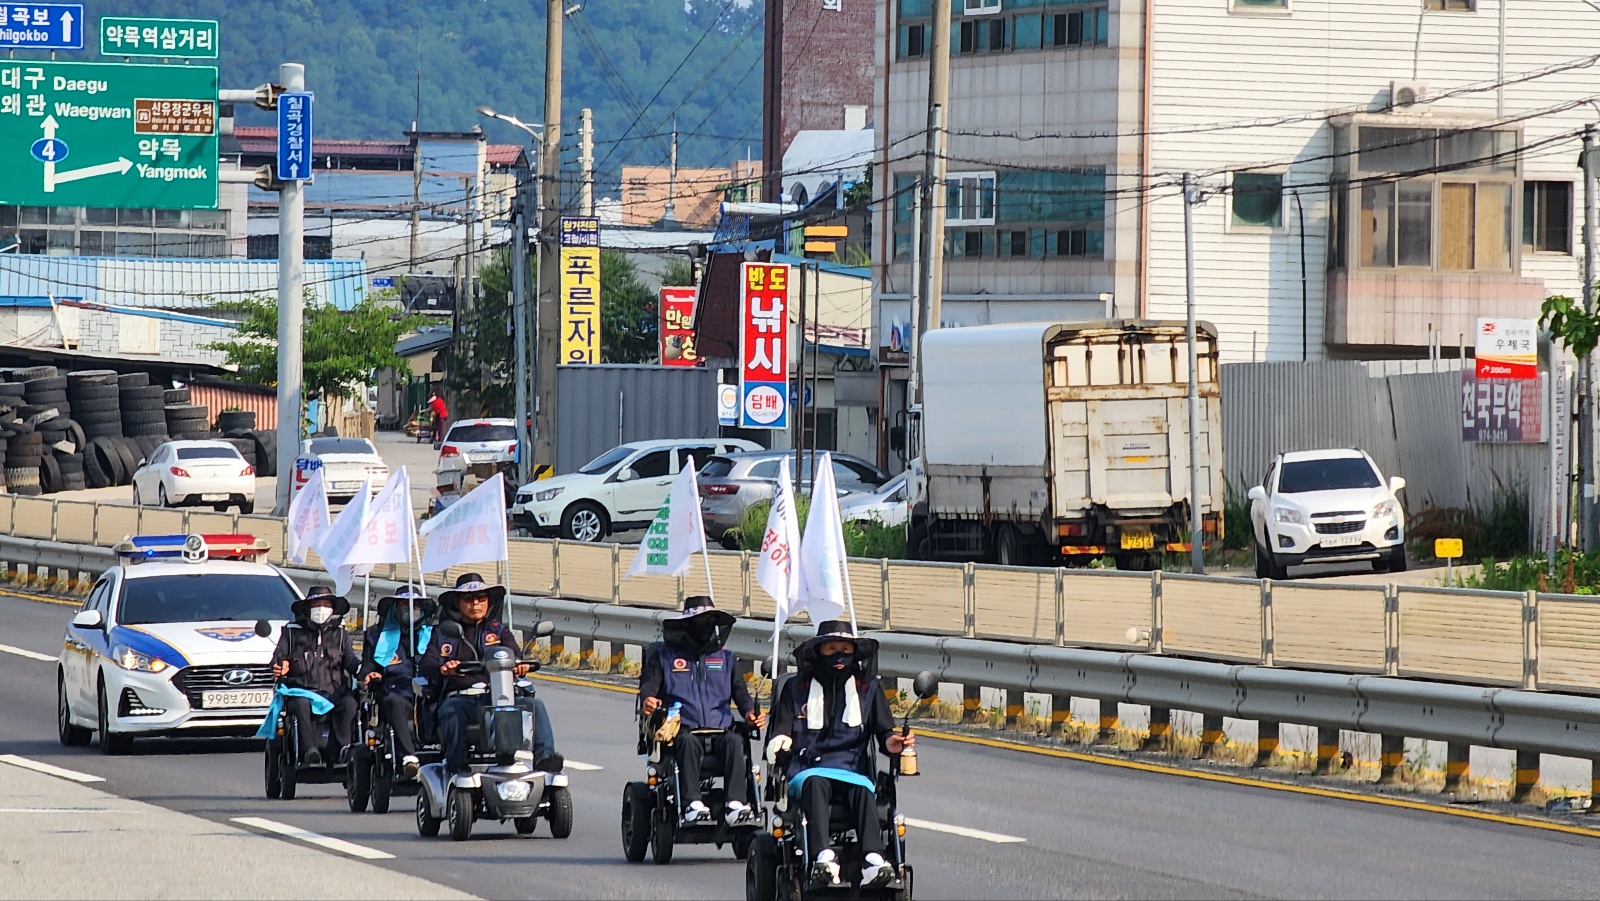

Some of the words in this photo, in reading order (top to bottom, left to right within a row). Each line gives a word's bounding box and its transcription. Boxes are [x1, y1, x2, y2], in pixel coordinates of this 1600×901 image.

[106, 26, 213, 51] 약목역삼거리
[1, 67, 46, 90] 대구
[53, 76, 108, 93] Daegu
[1, 94, 47, 117] 왜관
[55, 102, 131, 120] Waegwan
[151, 102, 212, 117] 신유장군유적
[286, 96, 304, 164] 칠곡경찰서
[42, 140, 55, 160] 4
[138, 138, 182, 161] 약목
[136, 164, 208, 182] Yangmok
[748, 267, 786, 291] 반도
[747, 297, 785, 375] 낚시
[1495, 339, 1530, 351] 우체국
[751, 394, 778, 410] 담배
[240, 692, 269, 704] 2707
